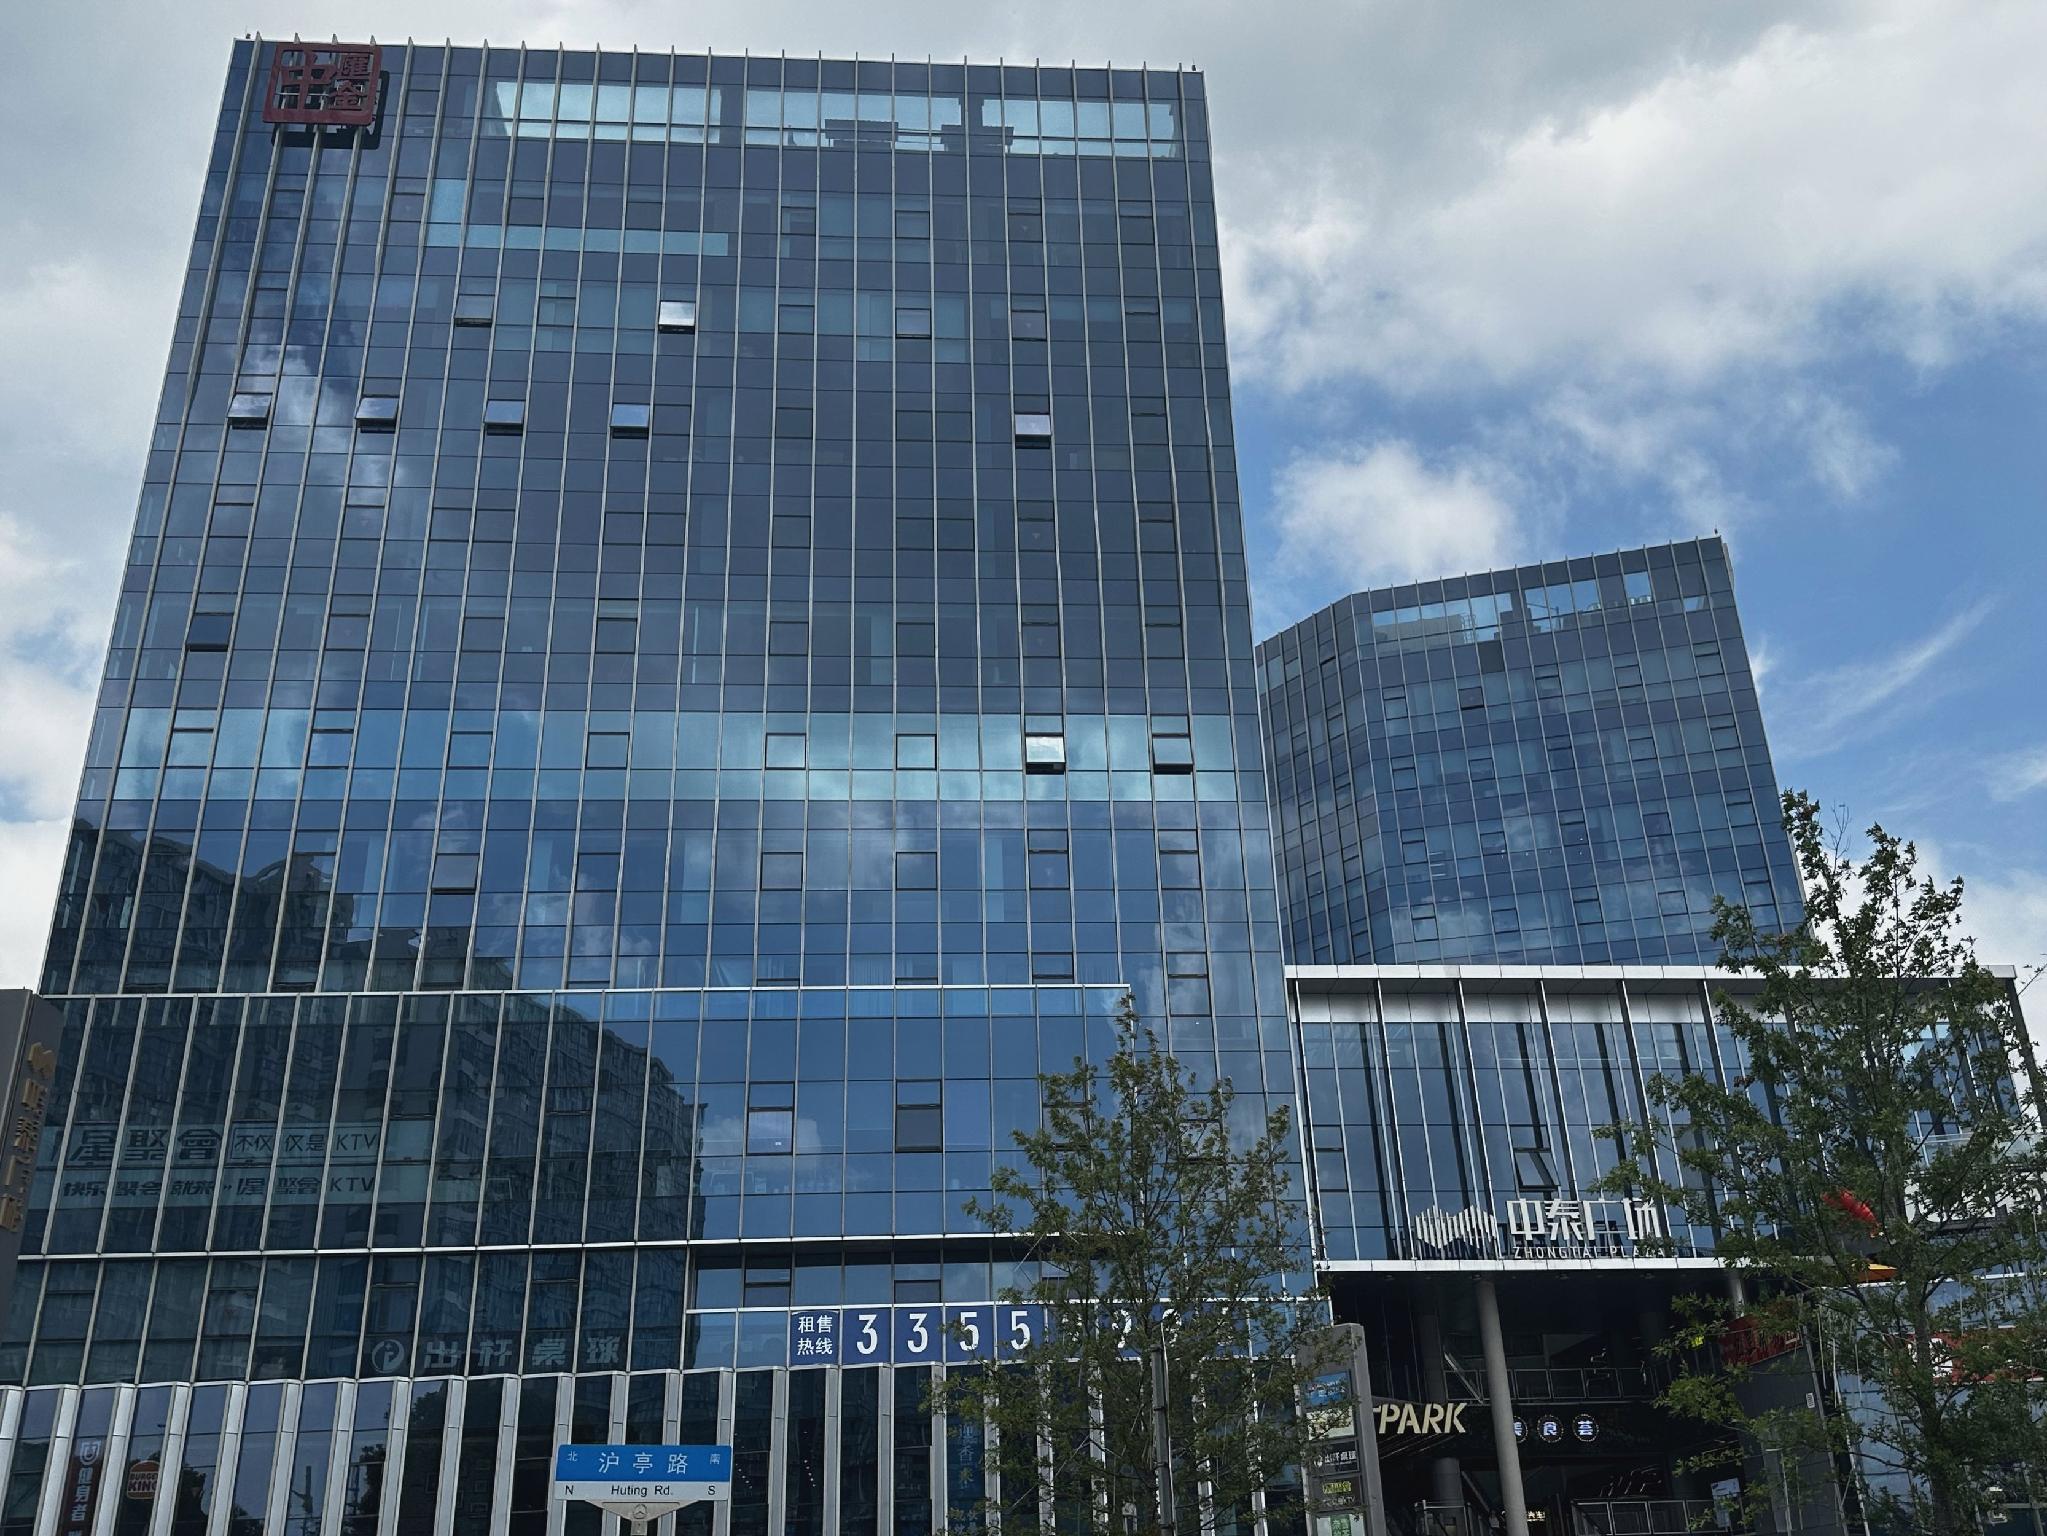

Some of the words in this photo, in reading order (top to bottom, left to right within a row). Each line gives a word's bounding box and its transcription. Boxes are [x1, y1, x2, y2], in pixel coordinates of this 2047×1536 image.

[1507, 1198, 1662, 1240] 中泰广场
[1513, 1247, 1598, 1259] ZHONGTAI
[798, 1314, 833, 1334] 租售
[797, 1337, 833, 1356] 热线
[1372, 1402, 1468, 1434] PARK
[566, 1451, 578, 1462] 北
[598, 1451, 689, 1475] 沪亭路
[709, 1453, 721, 1465] 南
[564, 1485, 575, 1496] N
[611, 1485, 648, 1498] Huting
[654, 1485, 674, 1496] Rd.
[707, 1485, 716, 1496] S
